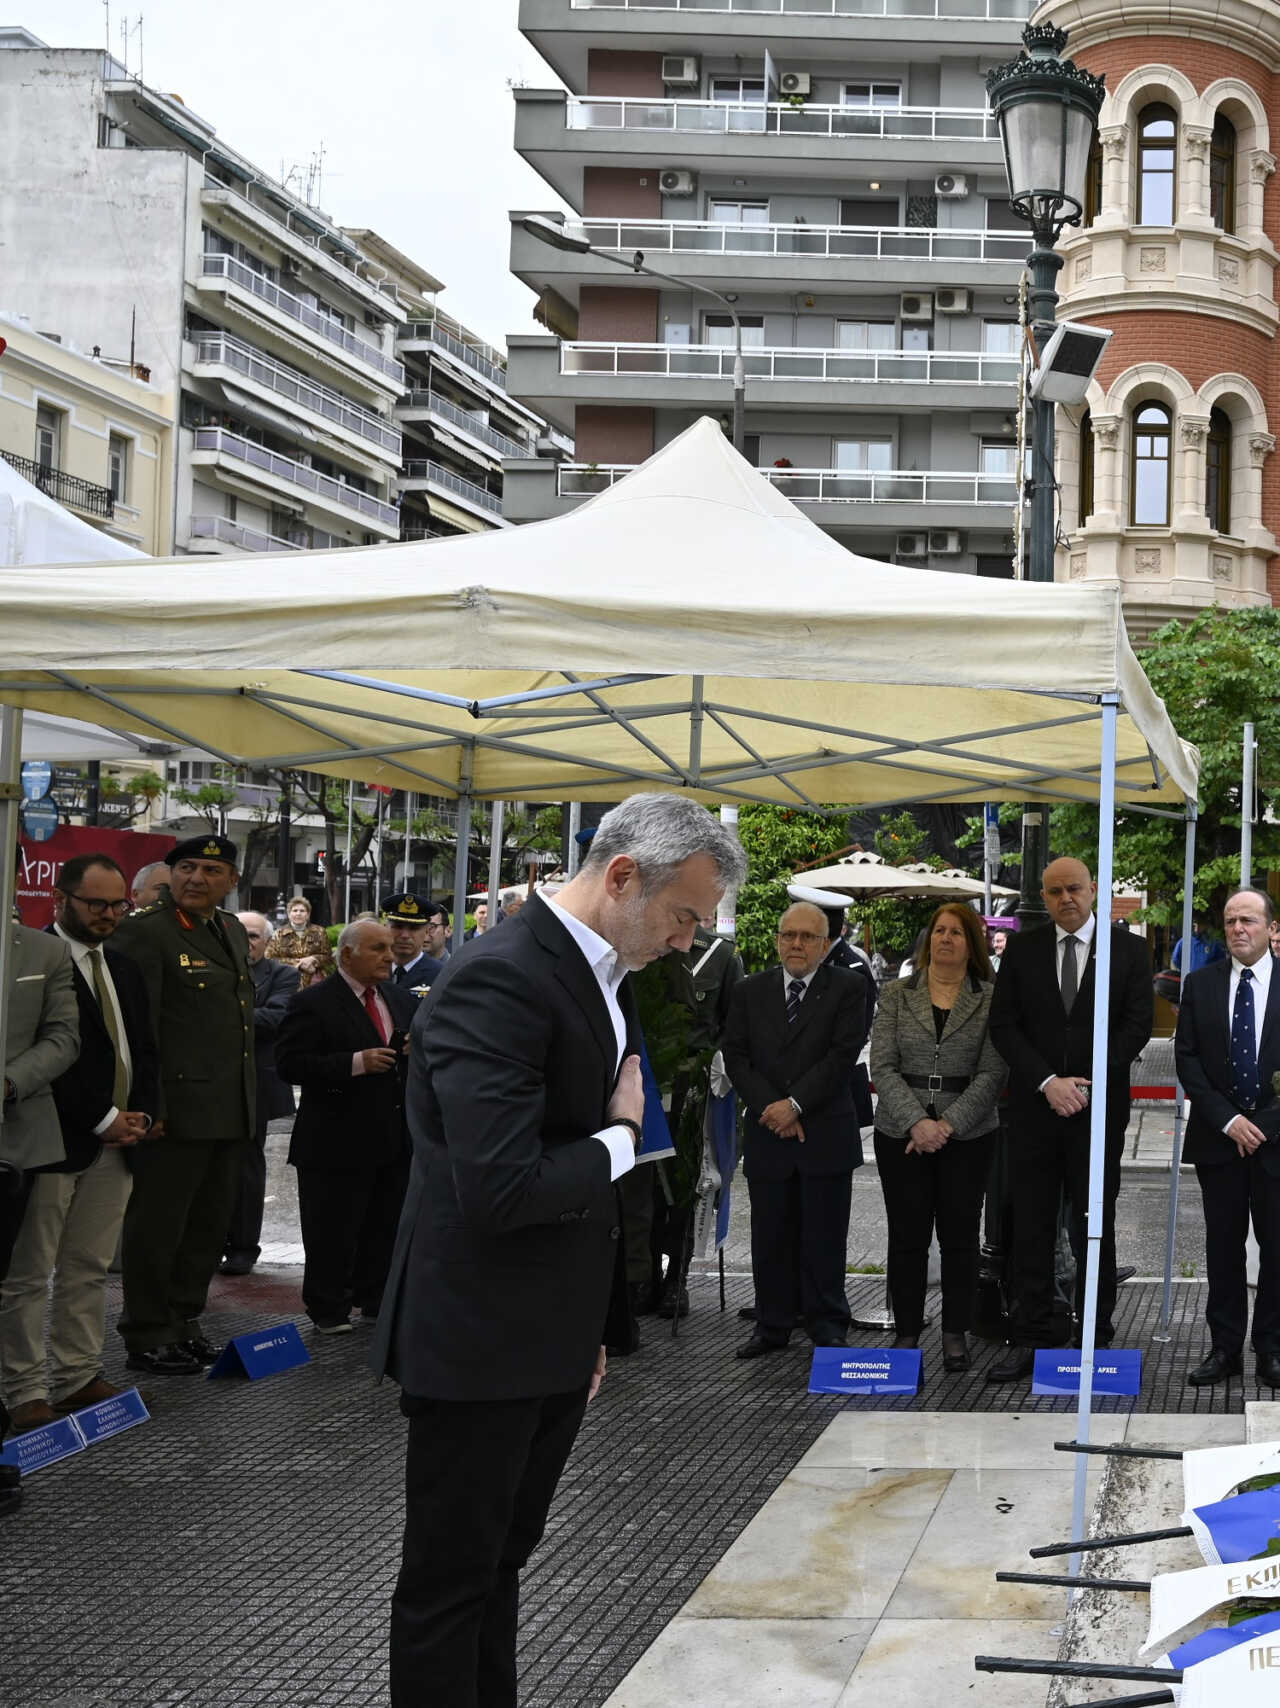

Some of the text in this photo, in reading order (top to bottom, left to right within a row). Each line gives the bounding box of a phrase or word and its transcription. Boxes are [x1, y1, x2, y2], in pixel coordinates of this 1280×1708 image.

[841, 1362, 891, 1370] ΜΗΤΡΟΠΟΛΙΤΗΣ
[1057, 1366, 1095, 1374] ΠΡΟΞΕΝΣ
[840, 1372, 889, 1380] ΘΕΣΣΑΛΟΝΙΚΗΣ
